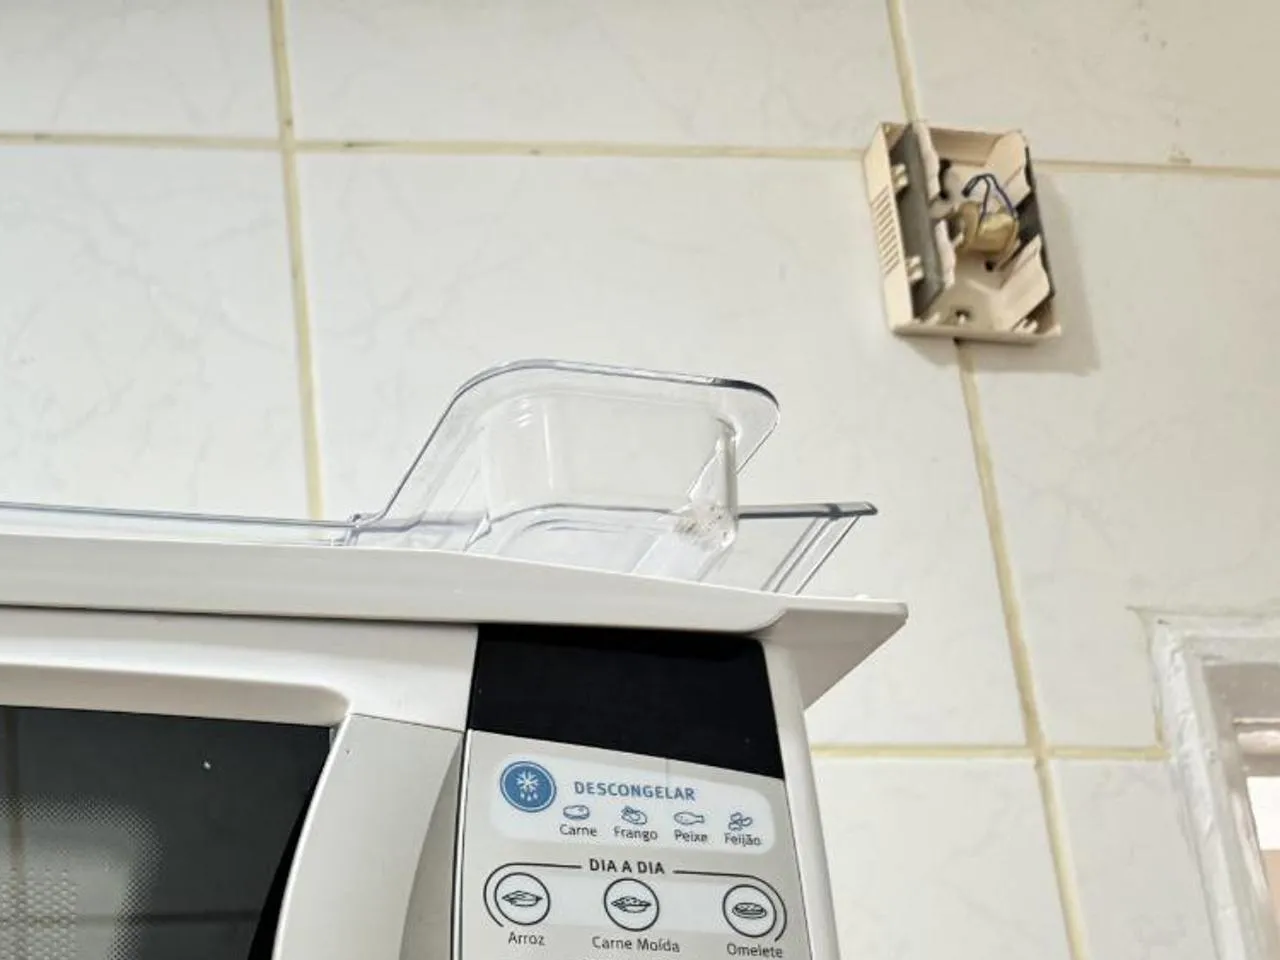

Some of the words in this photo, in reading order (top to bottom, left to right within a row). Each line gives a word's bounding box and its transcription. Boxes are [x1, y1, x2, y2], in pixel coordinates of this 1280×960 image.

[574, 781, 695, 801] DESCONGELAR
[560, 824, 597, 837] Carne
[614, 828, 658, 842] Frango
[675, 831, 708, 843] Peixe
[725, 833, 761, 847] Feijão
[590, 859, 616, 872] DIA
[622, 861, 632, 873] A
[637, 861, 665, 874] DIA
[508, 932, 545, 946] Arroz
[592, 937, 632, 950] Carne
[641, 938, 680, 953] Moída
[727, 943, 783, 958] Omelete
